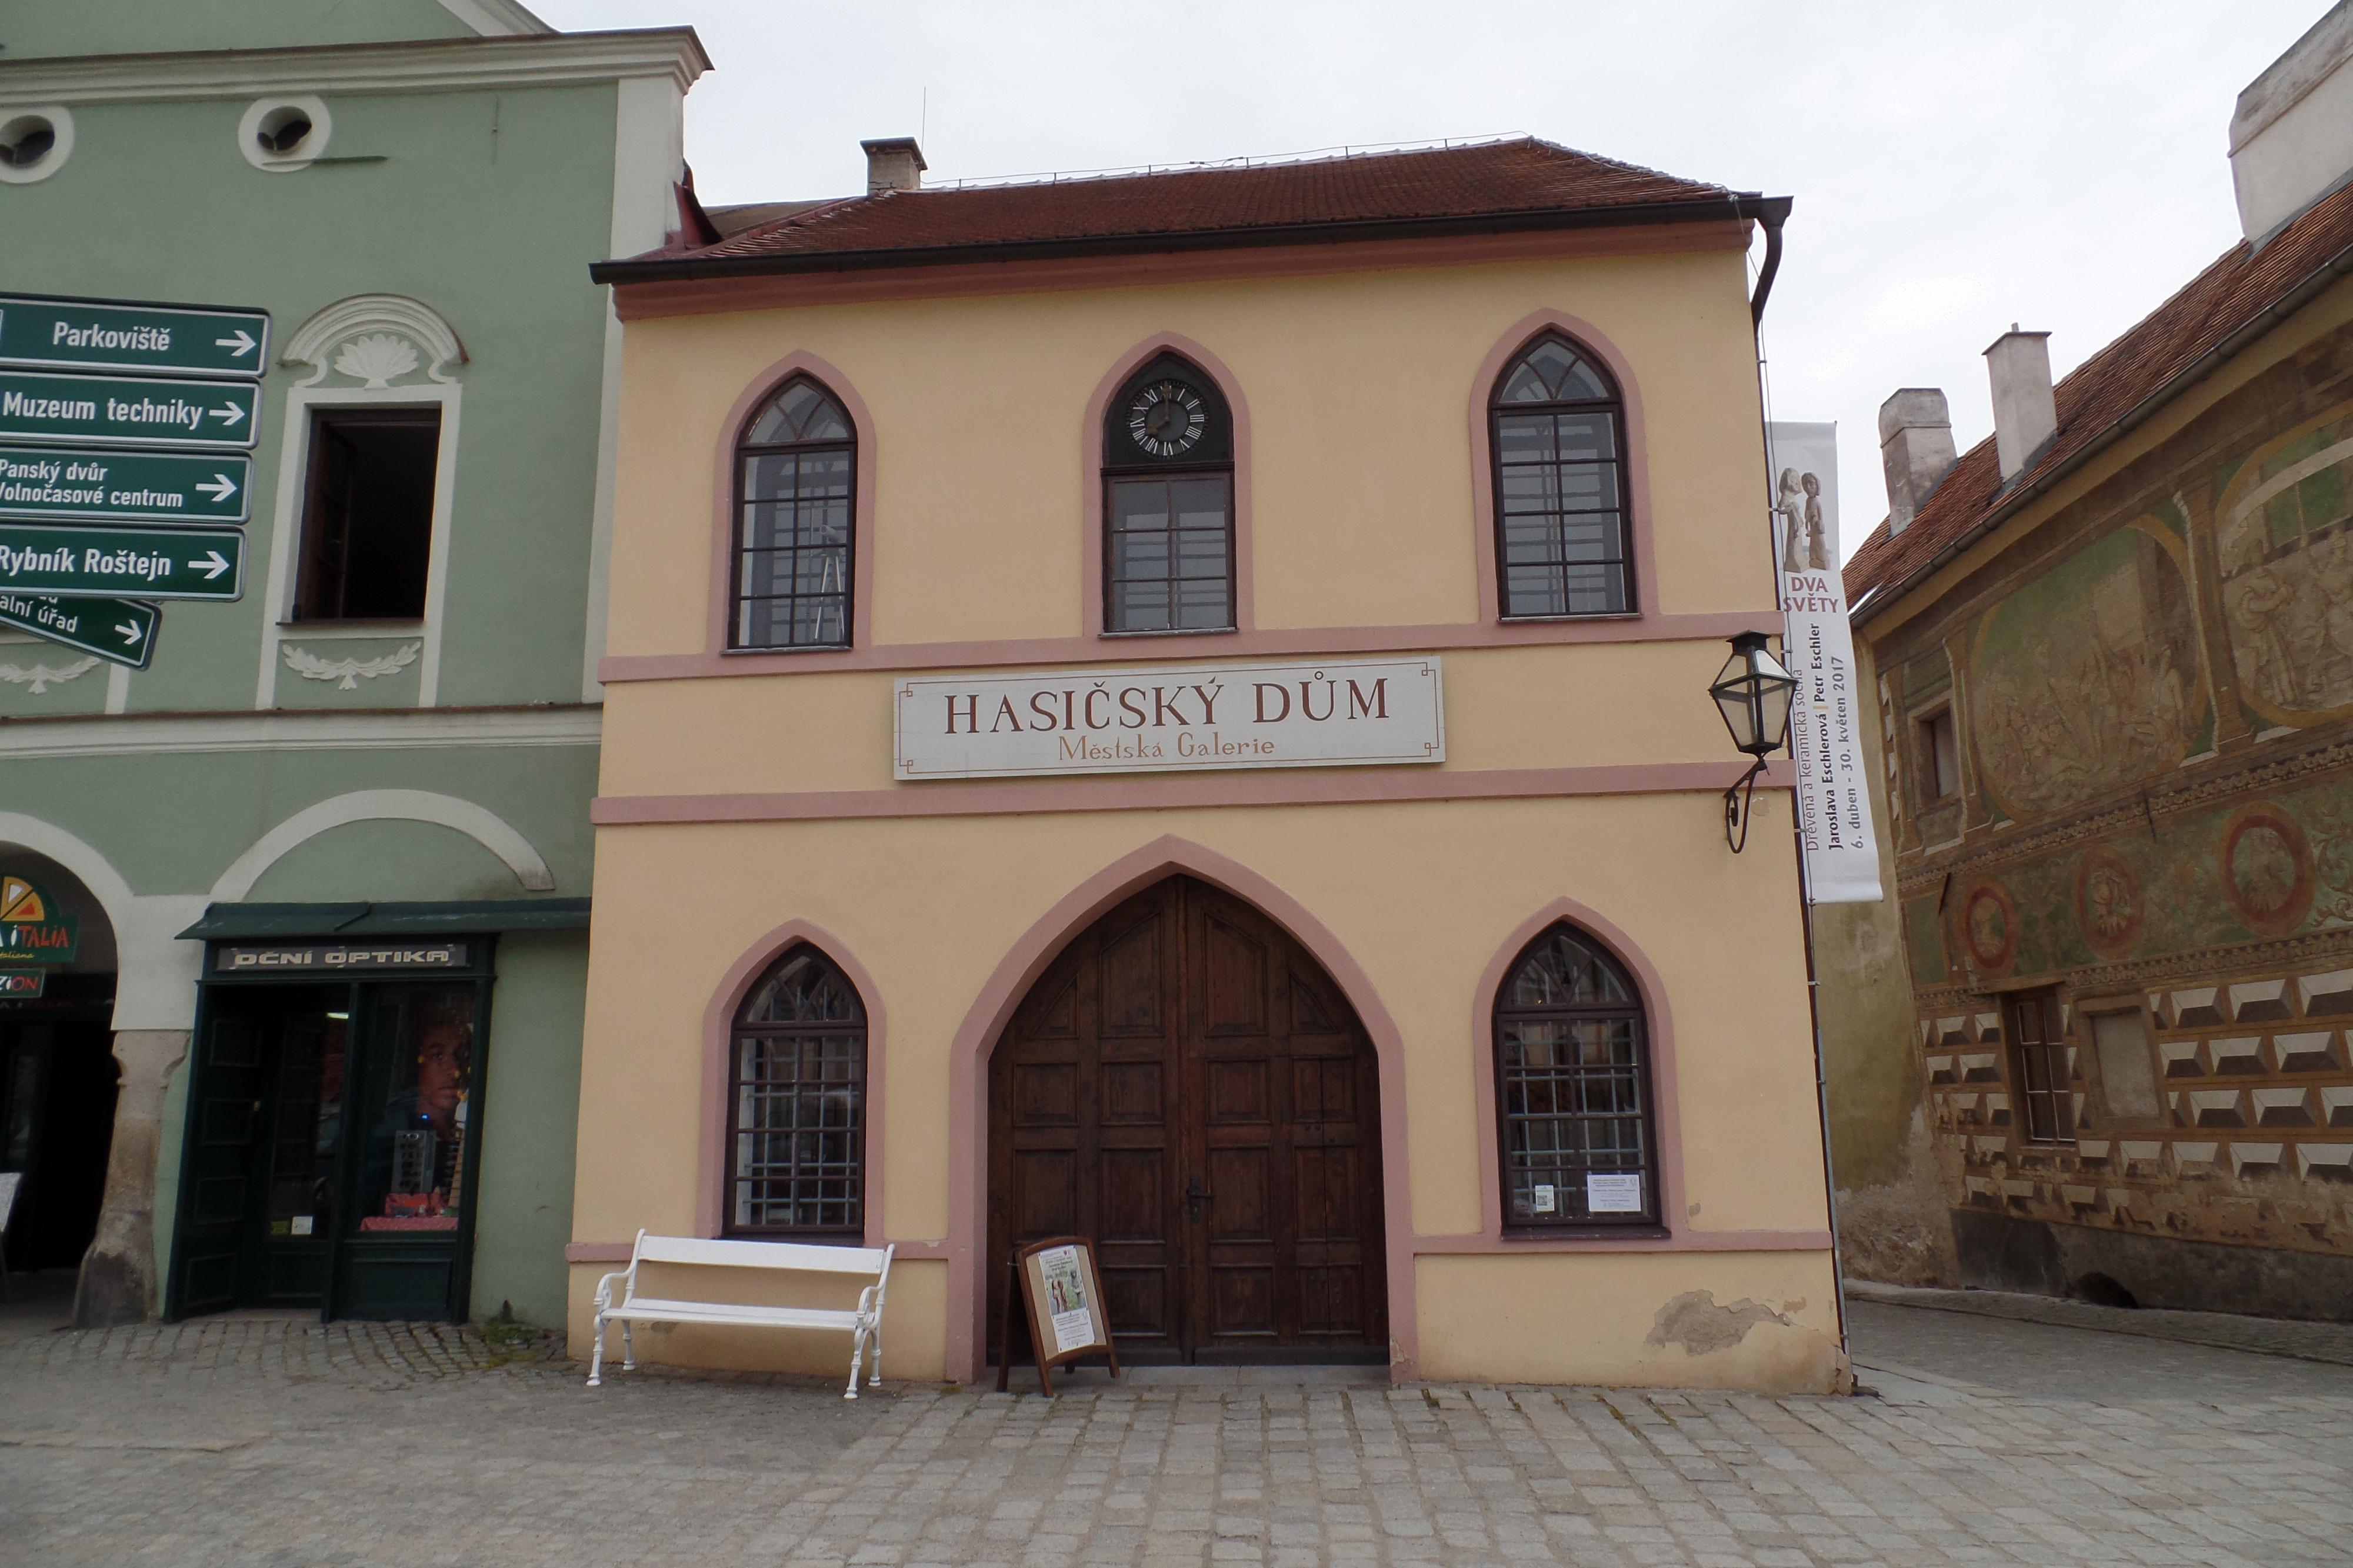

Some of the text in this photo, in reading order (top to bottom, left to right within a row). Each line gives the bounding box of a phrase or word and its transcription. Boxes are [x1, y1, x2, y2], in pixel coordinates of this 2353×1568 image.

[53, 321, 171, 351] Parkoviště
[3, 391, 204, 430] Muzeum techniky
[0, 459, 108, 483] Panský dvůr
[111, 489, 183, 508] centrum
[0, 545, 171, 581] Rybník Roštejn
[1791, 576, 1828, 593] DVA
[1784, 593, 1839, 613] SVĚTY
[38, 606, 78, 633] úřad
[1831, 656, 1845, 691] 2017
[944, 670, 1389, 734] HASIČSKÝ DŮM
[1835, 698, 1849, 742] květen
[1059, 732, 1275, 760] Městská Galerie
[1809, 623, 1844, 850] Jaroslava Eschlerová Petr Eschler
[1840, 749, 1853, 771] 30.
[1847, 789, 1861, 829] duben
[1851, 836, 1864, 849] 6.
[235, 949, 449, 966] OČNÍ OPTIKA
